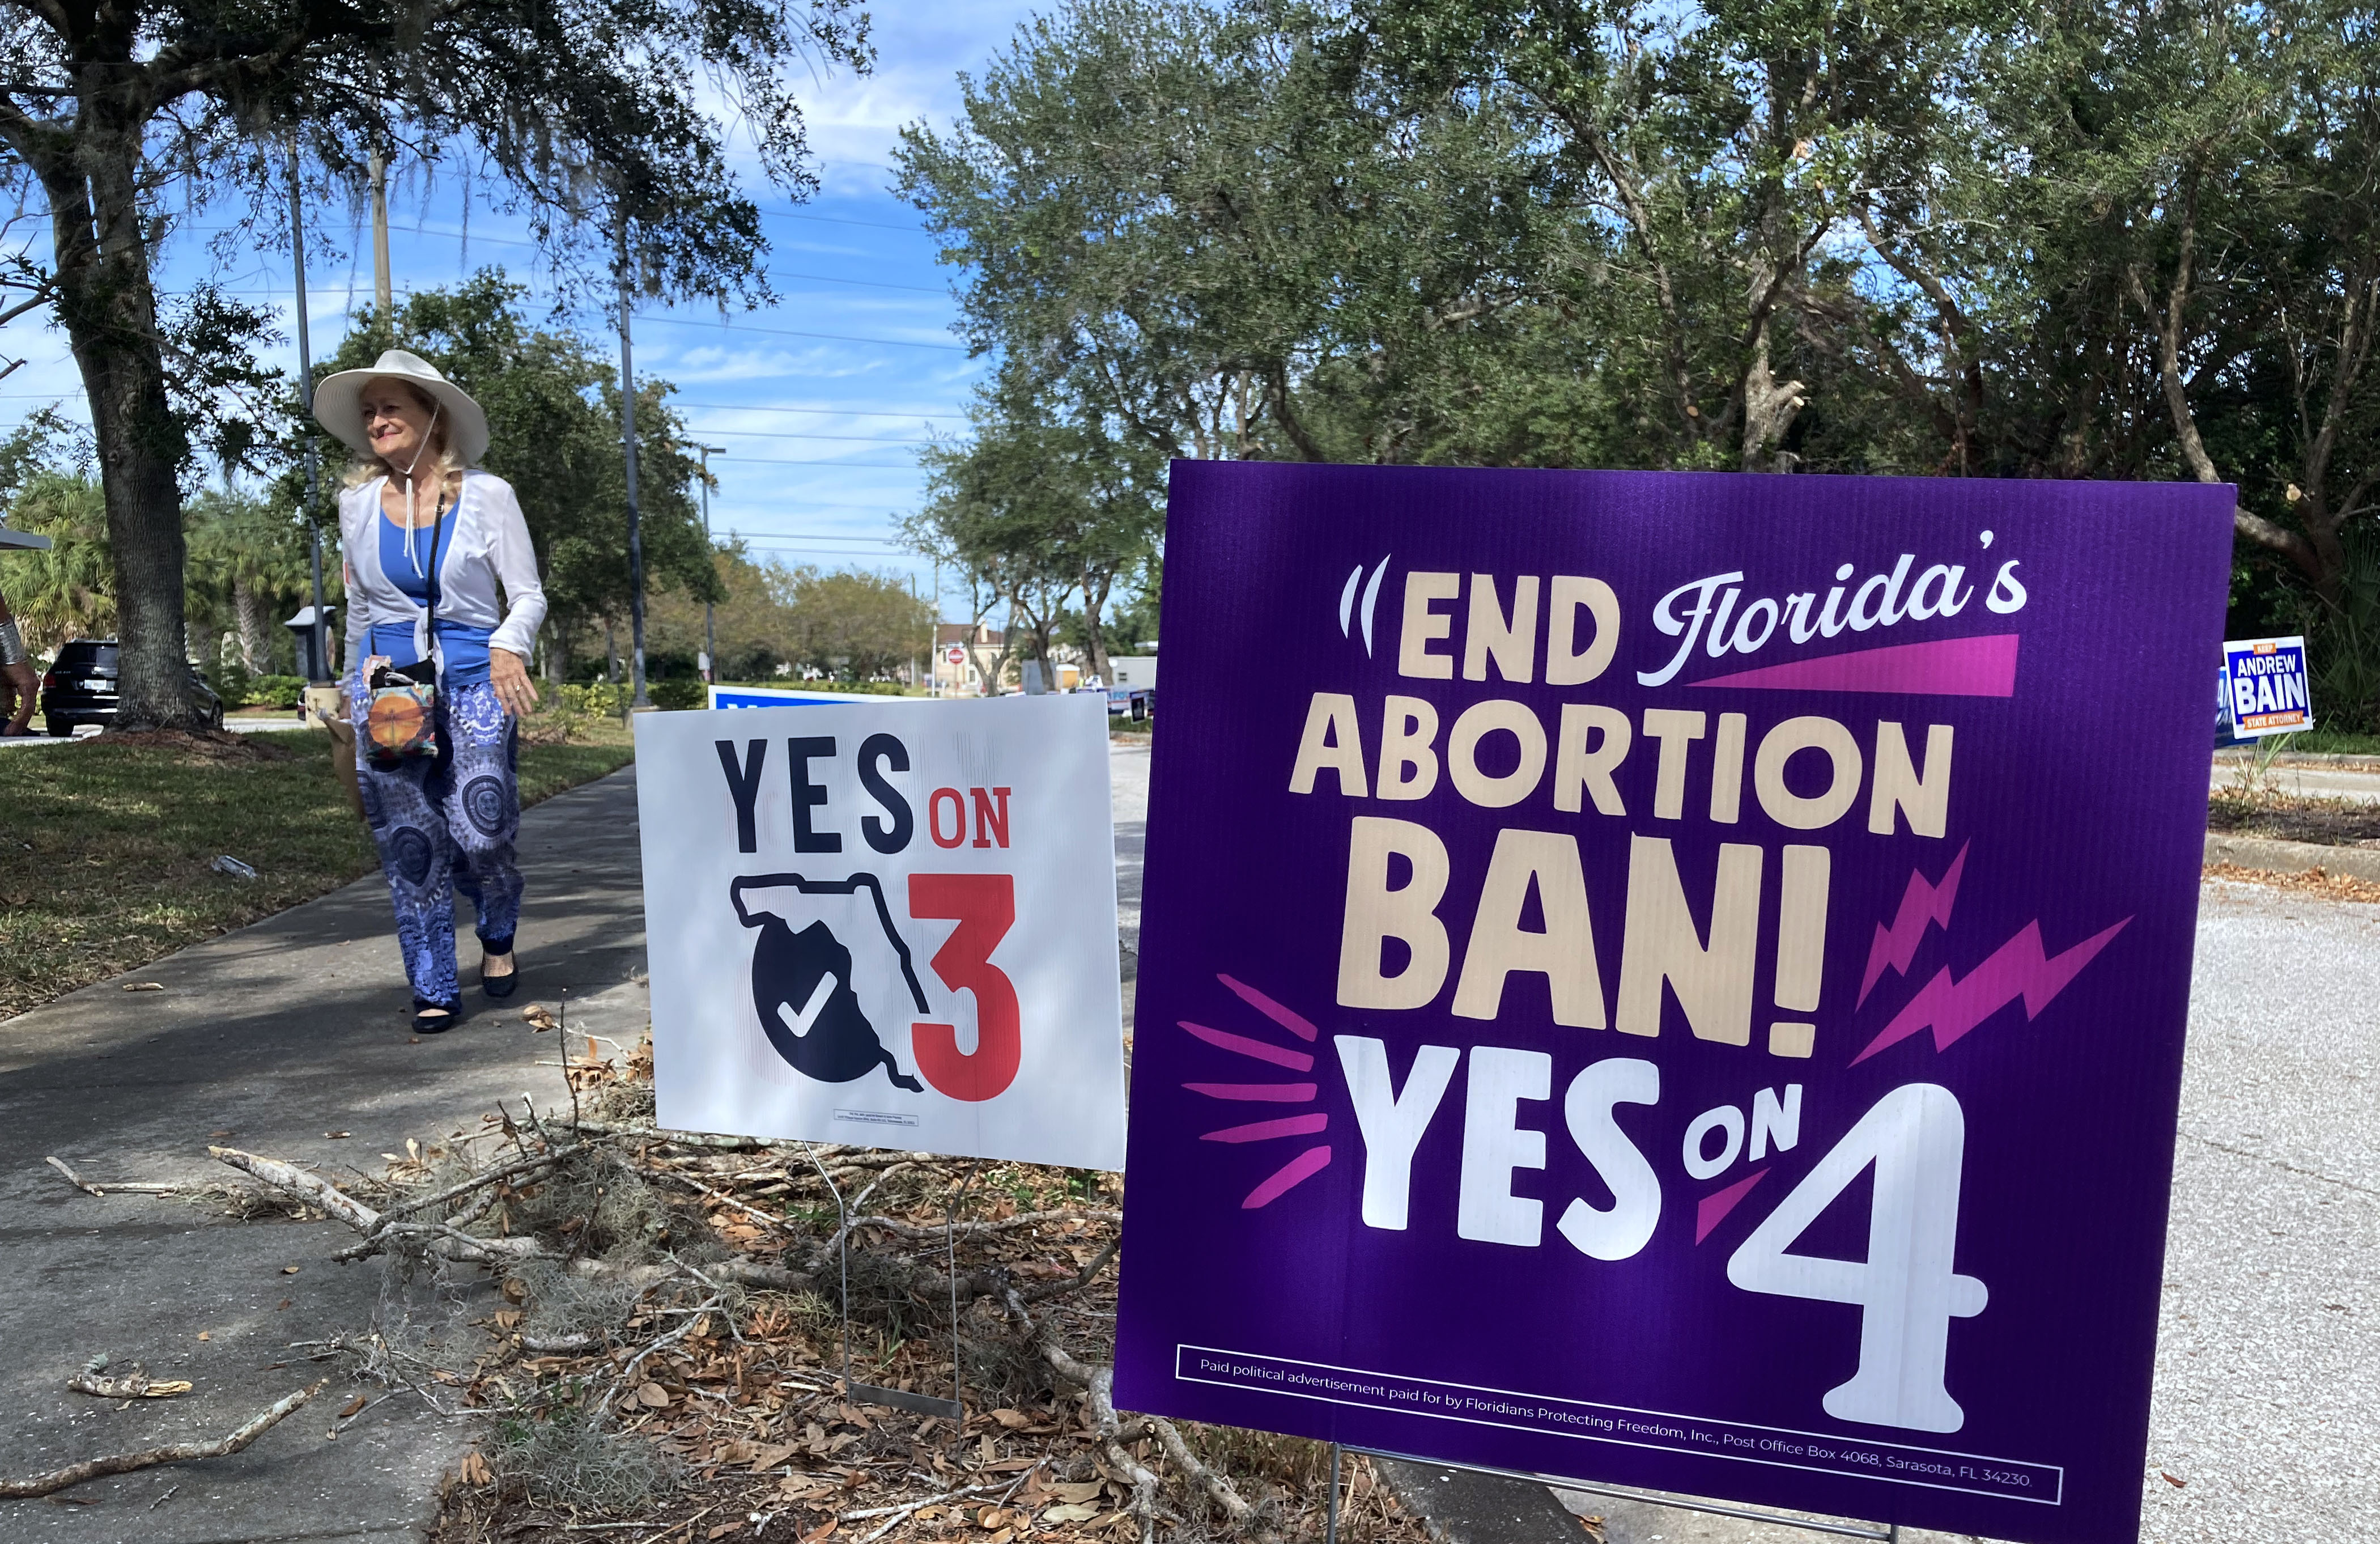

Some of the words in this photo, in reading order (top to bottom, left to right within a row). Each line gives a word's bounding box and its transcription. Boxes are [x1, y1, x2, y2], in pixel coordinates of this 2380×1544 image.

[1399, 571, 1620, 685] END
[1637, 531, 2027, 686] Florida's
[2238, 654, 2296, 677] ANDREW
[2234, 672, 2305, 715] BAIN
[2247, 718, 2267, 728] STATE
[2268, 714, 2301, 726] ATTORNEY
[715, 733, 913, 854] YES
[929, 787, 1011, 849] ON
[1289, 693, 1953, 838] ABORTION
[908, 874, 1021, 1101] 3
[1337, 816, 1830, 1058] BAN!
[1334, 1035, 1661, 1261] YES
[1683, 1084, 1802, 1180] ON
[1727, 1083, 1988, 1433] 4
[1200, 1359, 1230, 1374] Paid
[1232, 1365, 1285, 1381] political
[1287, 1373, 1385, 1397] advertisement
[1389, 1389, 1418, 1401] paid
[1423, 1392, 1441, 1404] for
[1446, 1394, 1463, 1409] by
[1467, 1398, 1534, 1417] Floridians
[1538, 1408, 1613, 1431] Protecting
[1617, 1419, 1686, 1441] Freedom,
[1692, 1430, 1719, 1445] Inc.,
[1724, 1434, 1755, 1448] Post
[1759, 1439, 1803, 1454] Office
[1808, 1445, 1835, 1459] Box
[1841, 1452, 1882, 1467] 4068,
[1886, 1456, 1956, 1477] Sarasota,
[1959, 1466, 1978, 1480] FL
